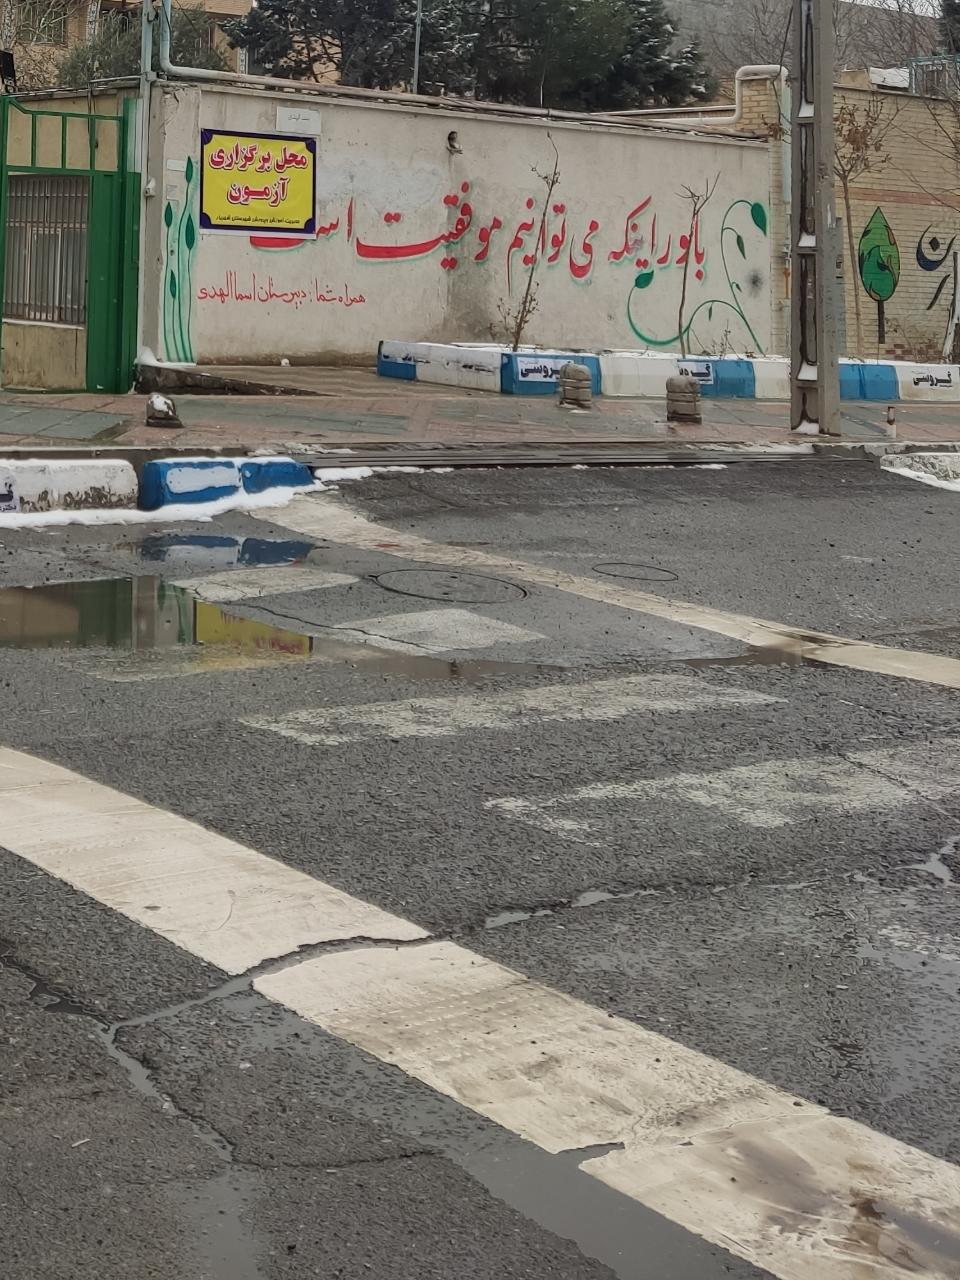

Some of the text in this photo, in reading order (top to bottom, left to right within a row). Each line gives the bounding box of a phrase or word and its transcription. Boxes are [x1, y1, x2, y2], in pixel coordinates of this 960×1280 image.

[209, 143, 308, 172] محل برگزاری
[227, 177, 290, 207] آزمون
[356, 181, 502, 270] موفقیت
[507, 198, 566, 296] توانیم
[570, 219, 600, 279] می
[258, 275, 307, 309] دبیرستان
[338, 283, 366, 307] همراه
